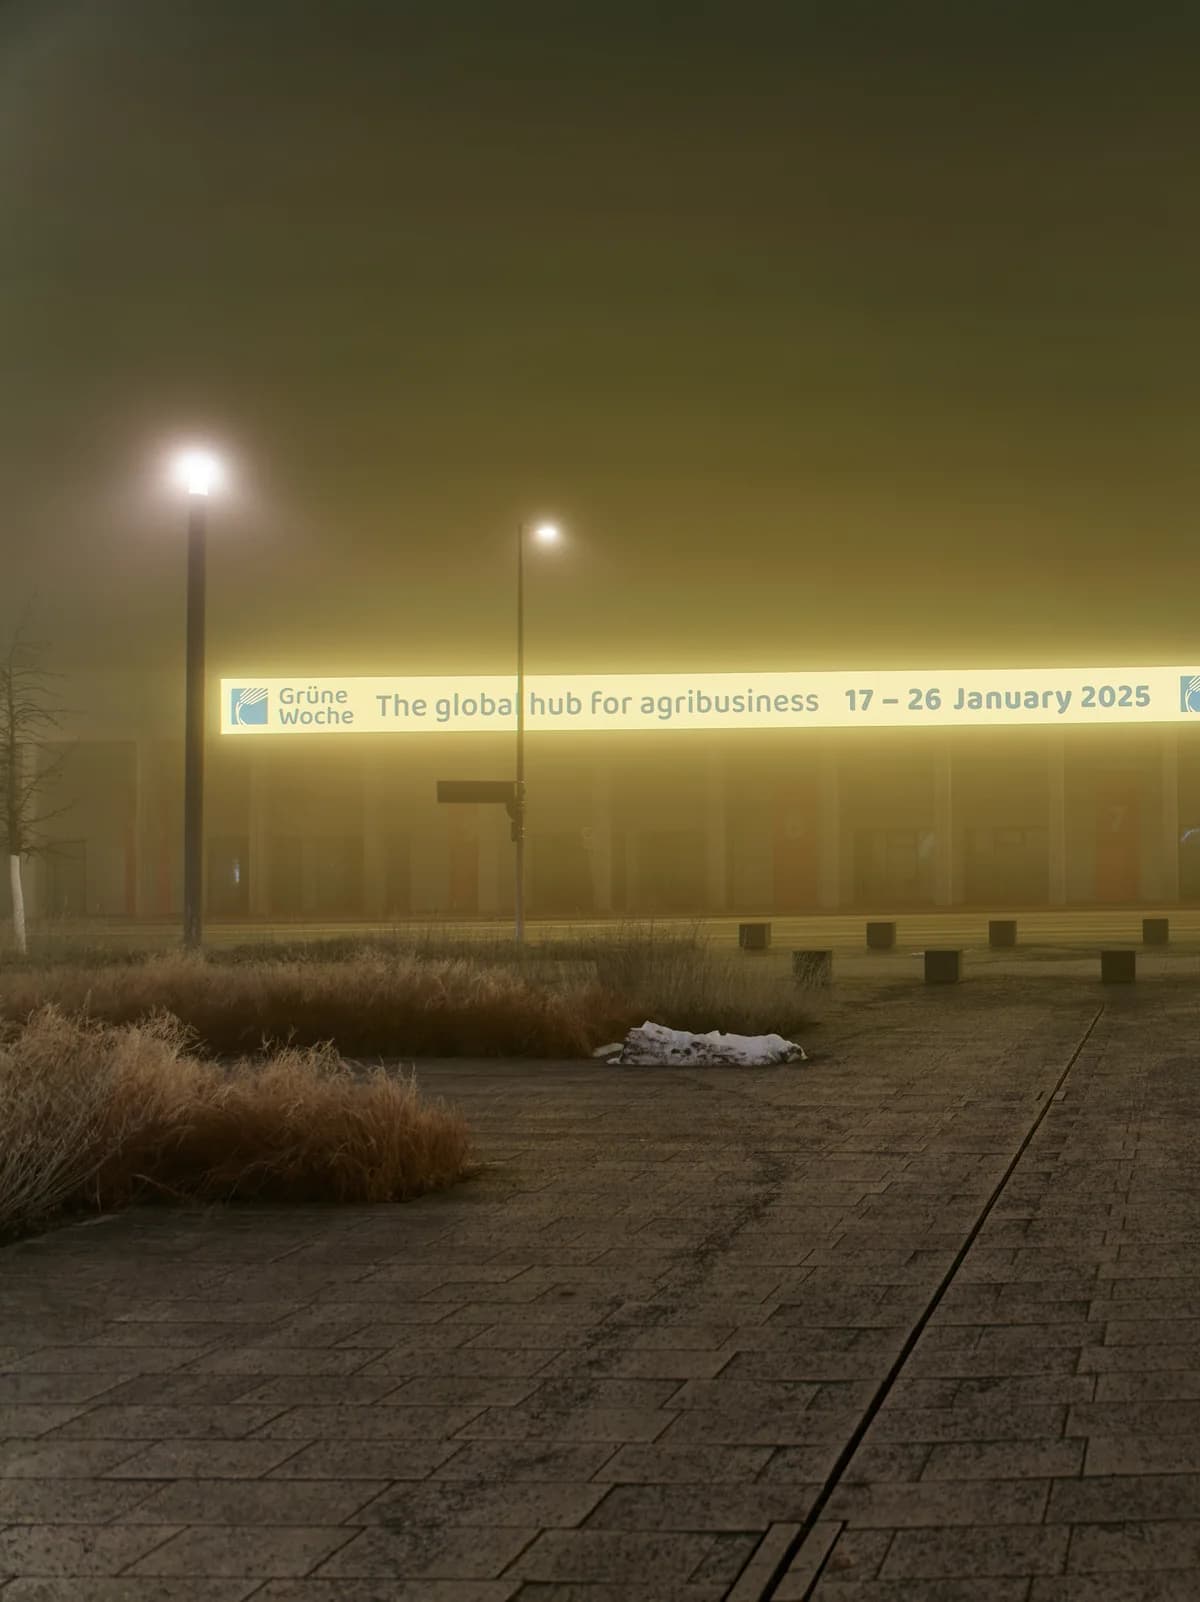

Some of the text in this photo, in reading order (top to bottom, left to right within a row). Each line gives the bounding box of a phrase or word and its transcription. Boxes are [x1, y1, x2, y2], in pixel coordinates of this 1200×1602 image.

[279, 685, 348, 704] Grüne
[376, 693, 427, 716] The
[530, 691, 582, 715] hub
[591, 690, 632, 714] for
[641, 688, 818, 720] agribusiness
[845, 688, 873, 711] 17
[907, 687, 942, 710] 26
[953, 687, 1072, 715] January
[1081, 685, 1150, 708] 2025
[278, 704, 354, 724] Woche
